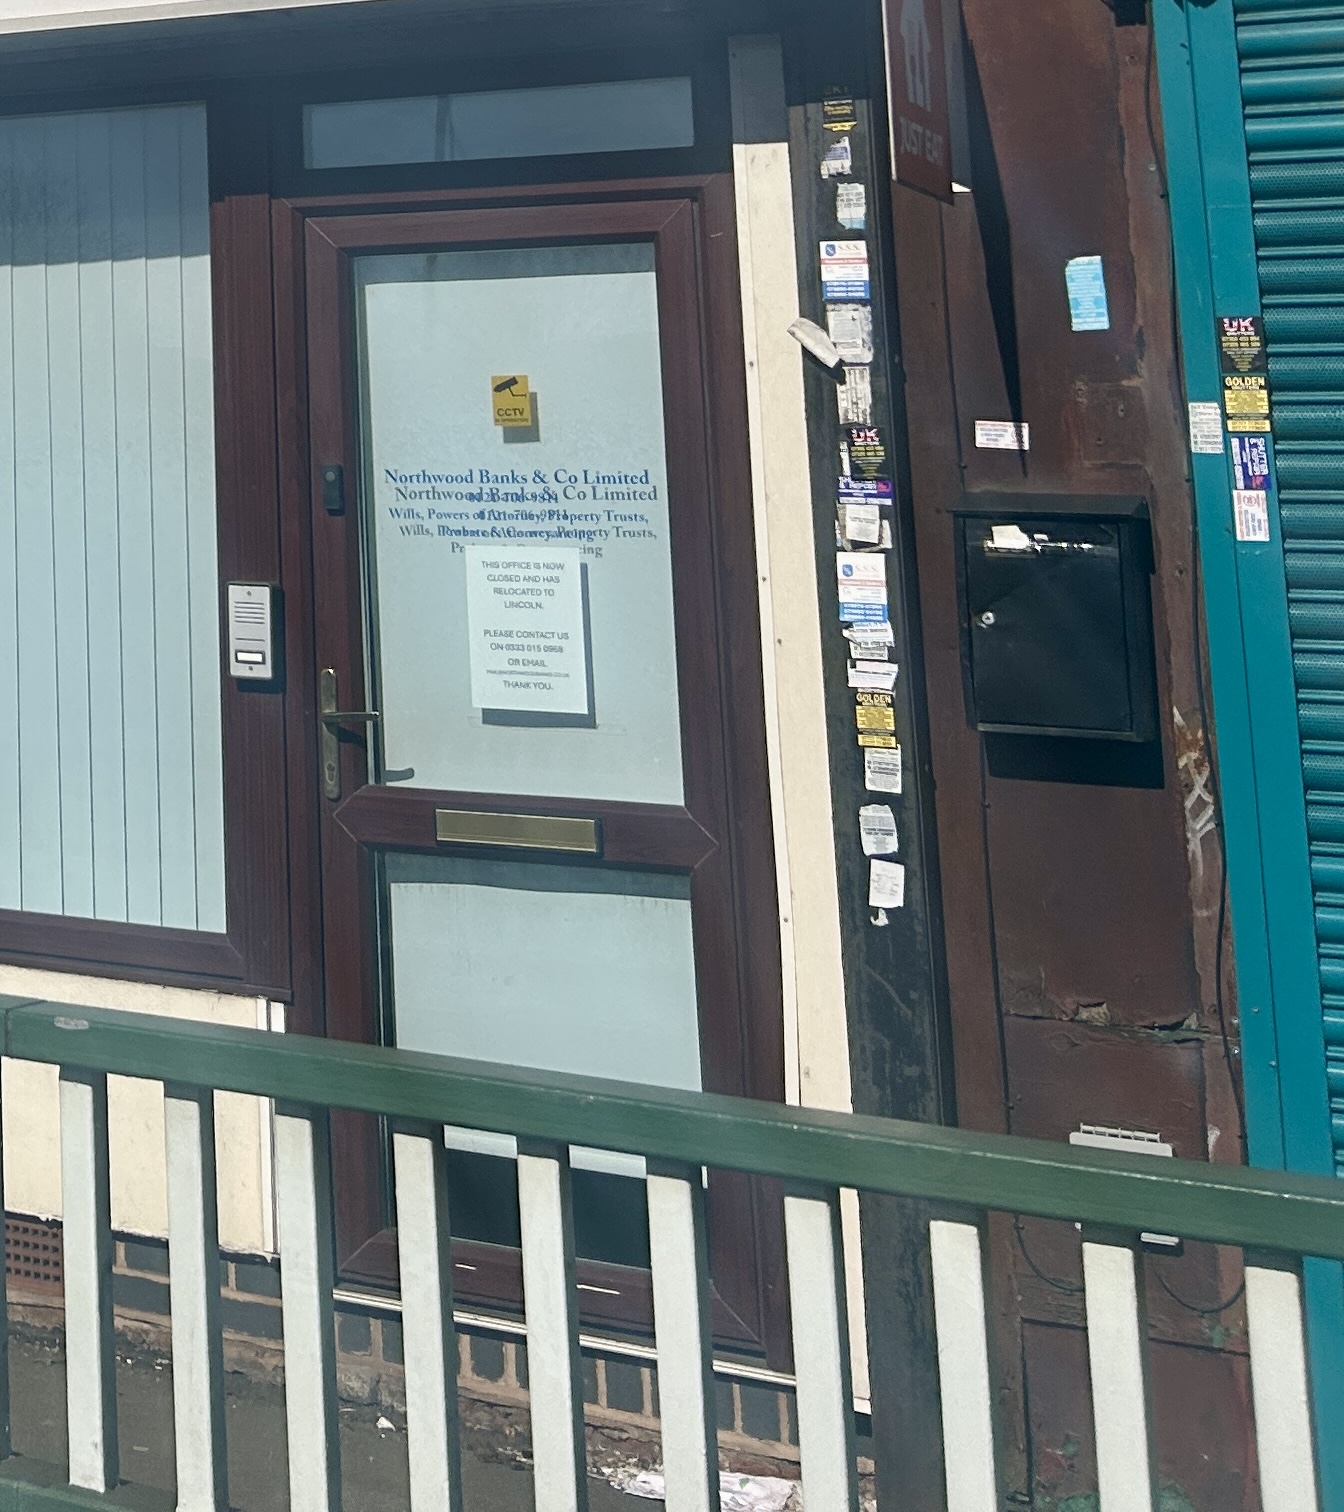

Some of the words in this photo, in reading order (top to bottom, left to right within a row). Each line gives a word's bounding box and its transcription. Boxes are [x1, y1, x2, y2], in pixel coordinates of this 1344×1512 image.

[899, 116, 924, 158] JUST
[1223, 317, 1254, 332] UK
[1225, 376, 1265, 387] GOLDEN
[497, 407, 525, 417] CCTV
[384, 469, 473, 484] Northwood
[478, 468, 528, 484] Banks
[532, 468, 550, 484] &
[554, 468, 578, 484] Co
[583, 469, 649, 485] Limited
[388, 507, 424, 522] Wills,
[427, 508, 470, 520] Powers
[603, 509, 649, 524] Trusts,
[481, 560, 500, 569] THIS
[501, 561, 531, 570] OFFICE
[533, 562, 541, 570] IS
[542, 562, 565, 571] NOW
[486, 575, 521, 583] CLOSED
[522, 575, 541, 583] AND
[542, 576, 560, 584] HAS
[493, 587, 542, 596] RELOCATED
[544, 588, 555, 597] TO
[504, 601, 544, 609] LINCOLN.
[483, 629, 514, 638] PLEASE
[516, 630, 555, 639] CONTACT
[557, 631, 569, 640] US
[490, 642, 504, 651] ON
[507, 658, 520, 666] OR
[522, 658, 548, 667] EMAIL
[503, 680, 532, 689] THANK
[533, 681, 554, 690] YOU.
[856, 693, 891, 704] GOLDEN
